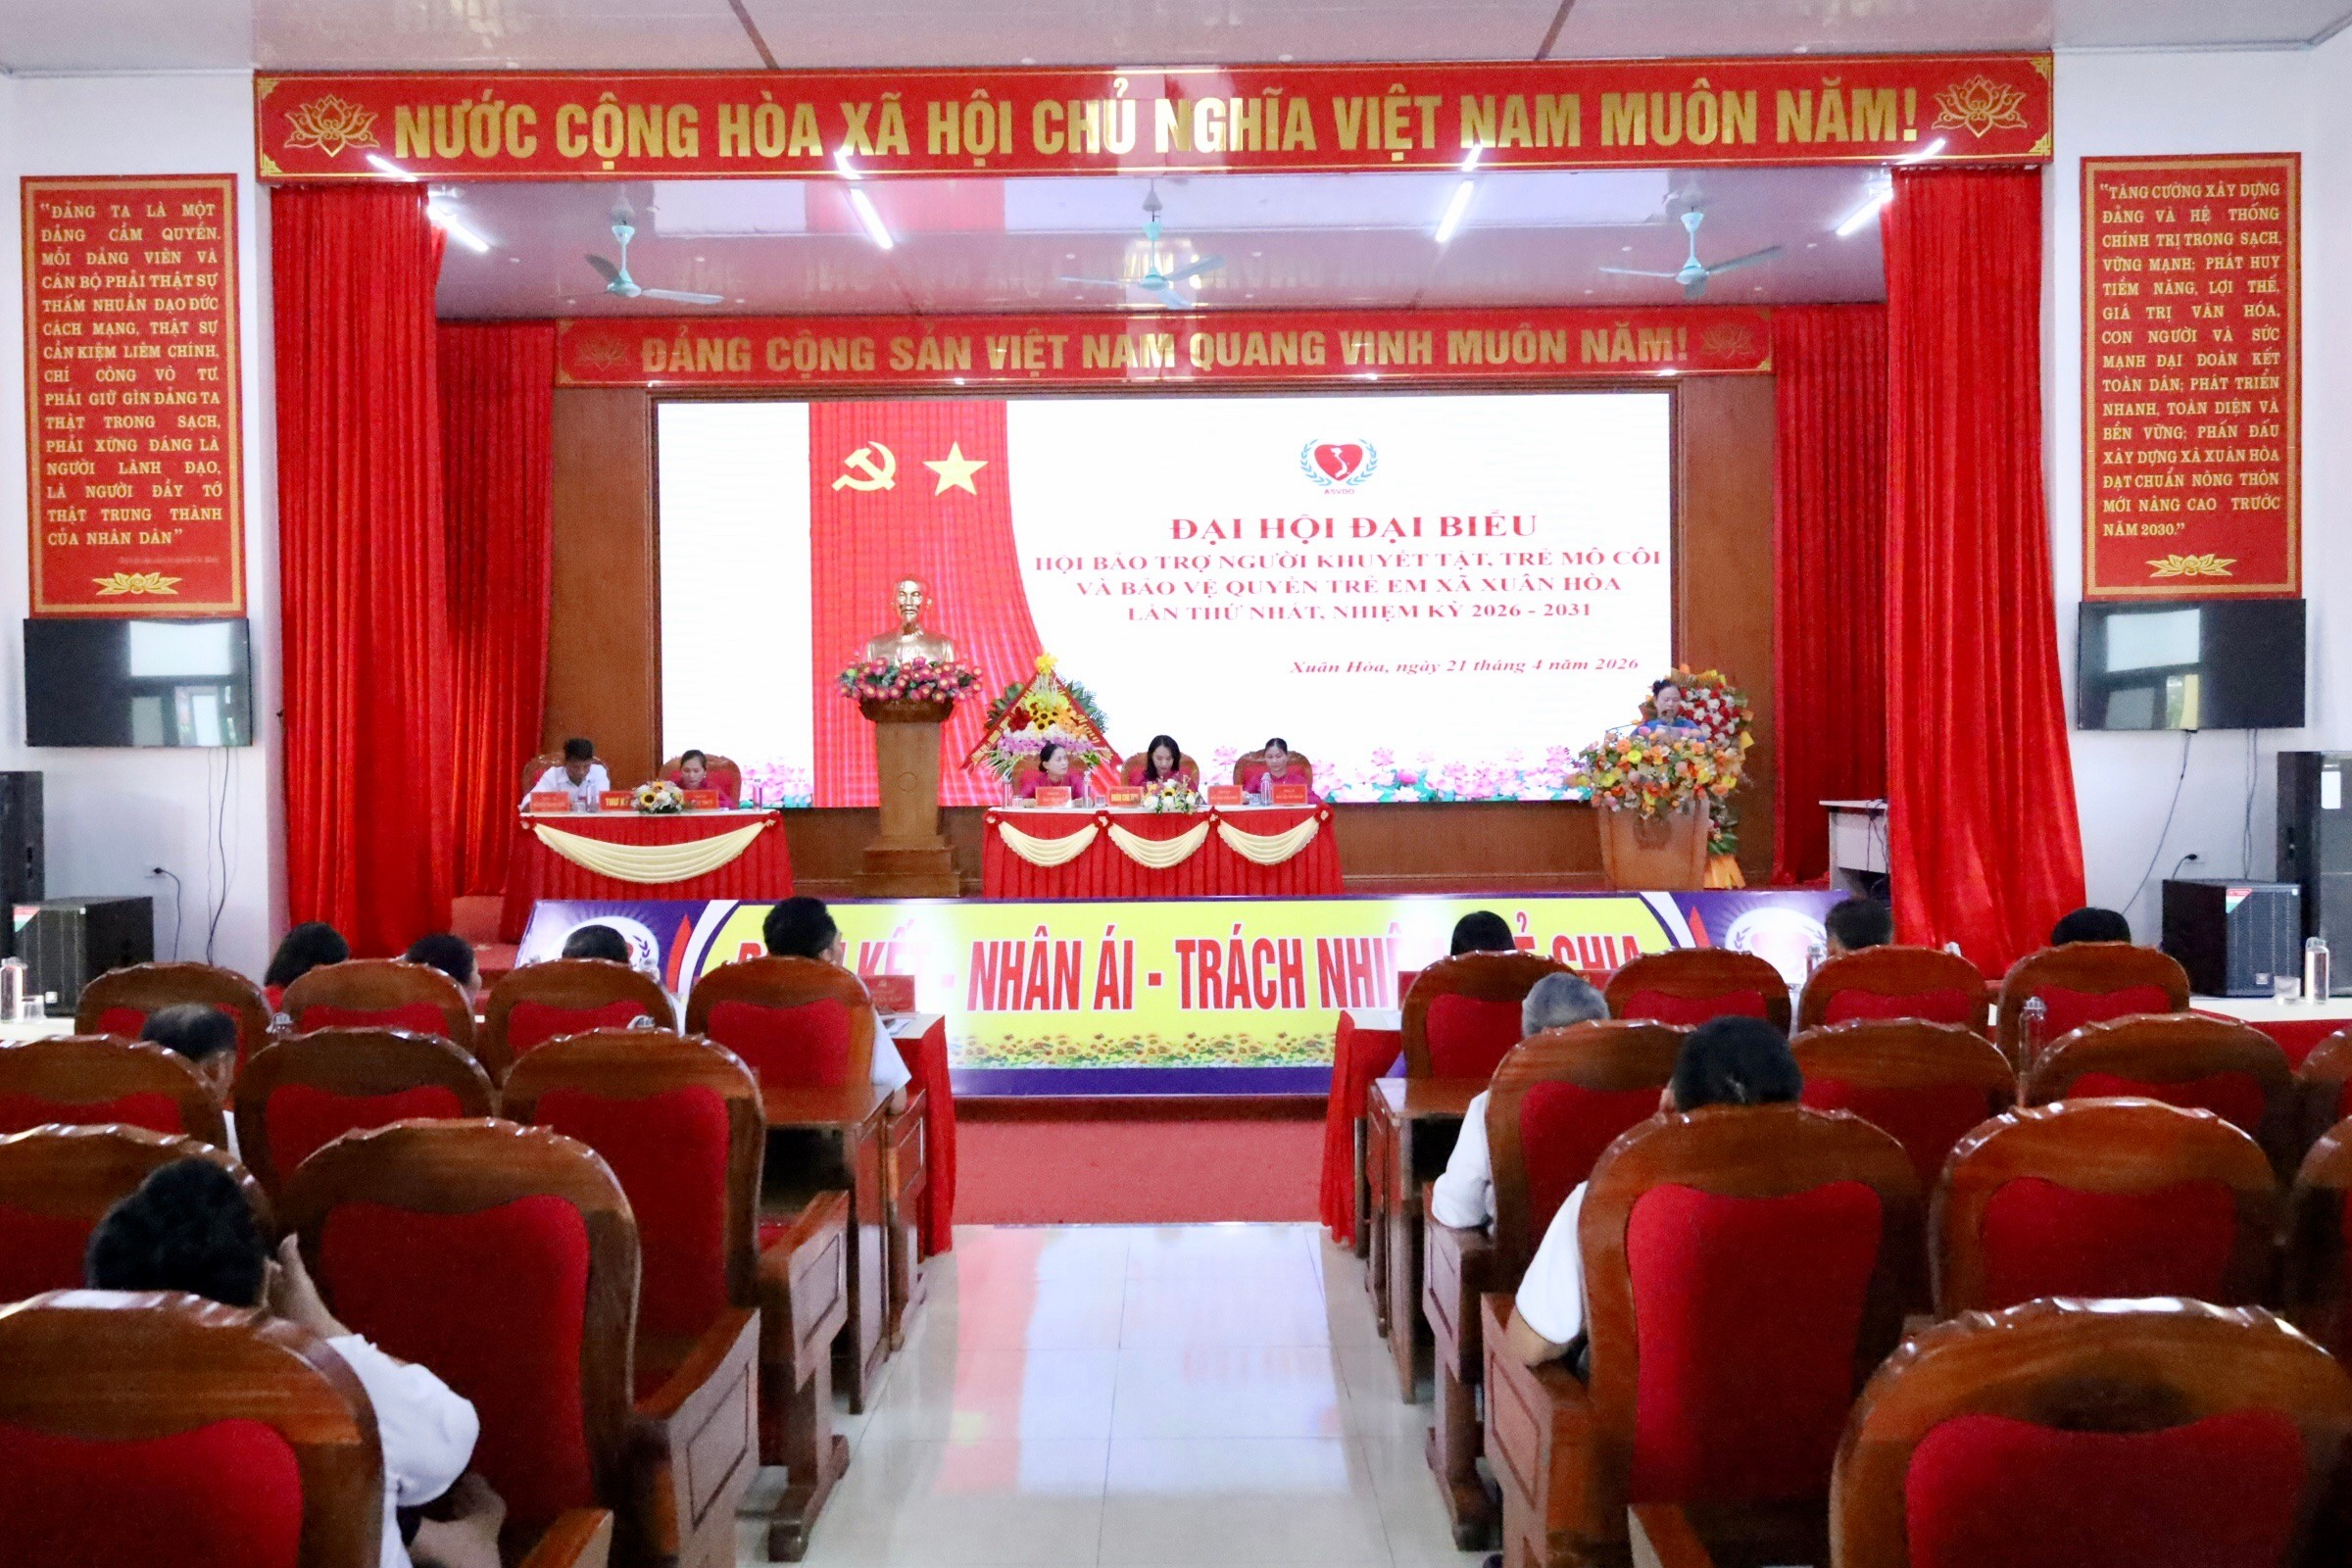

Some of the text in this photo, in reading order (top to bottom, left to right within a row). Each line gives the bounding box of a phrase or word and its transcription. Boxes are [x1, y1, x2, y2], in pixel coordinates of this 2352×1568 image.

[395, 75, 1918, 171] NƯỚC CỘNG HÒA XÃ HỘI CHỦ NGHĨA VIỆT NAM MUÔN NĂM!
[2205, 180, 2279, 198] XÂY DỰNG
[110, 205, 130, 218] TA
[146, 201, 167, 218] LÀ
[181, 200, 216, 219] MỘT
[2155, 206, 2176, 222] VÀ
[2229, 203, 2279, 220] THỐNG
[2102, 230, 2149, 248] CHÍNH
[2156, 233, 2180, 248] TRỊ
[2183, 232, 2233, 246] TRONG
[197, 248, 218, 264] VÀ
[2102, 256, 2142, 271] VỮNG
[2206, 253, 2243, 270] PHÁT
[2250, 256, 2279, 269] HUY
[42, 273, 74, 288] CÁN
[80, 272, 102, 290] BỘ
[149, 271, 193, 290] THẬT
[196, 272, 219, 290] SỰ
[2209, 279, 2232, 296] LỢI
[154, 298, 187, 314] ĐẠO
[189, 294, 219, 312] ĐỨC
[2102, 303, 2131, 320] GIÁ
[2145, 306, 2172, 321] TRỊ
[43, 320, 81, 335] CÁCH
[150, 318, 189, 337] THẬT
[199, 319, 219, 336] SỰ
[2101, 324, 2279, 344] CON NGƯỜI VÀ SỨC
[641, 320, 1688, 380] ĐẢNG CỘNG SẢN VIỆT NAM QUANG VINH MUÔN NĂM!
[2103, 348, 2280, 369] MẠNH ĐẠI ĐOÀN KẾT
[44, 367, 70, 382] CHÍ
[96, 366, 136, 382] CÔNG
[2102, 375, 2141, 392] TOÀN
[2190, 374, 2229, 390] PHÁT
[122, 389, 150, 405] GÌN
[200, 391, 220, 405] TA
[2167, 398, 2278, 416] TOÀN DIỆN VÀ
[104, 416, 155, 429] TRONG
[149, 435, 193, 452] ĐÁNG
[200, 435, 220, 452] LÀ
[2137, 446, 2279, 466] DỰNG HÒA
[47, 459, 95, 475] NGƯỜI
[2192, 470, 2232, 486] NÔNG
[2239, 469, 2278, 485] THÔN
[47, 481, 223, 499] LÀ NGƯỜI TỚ
[2102, 493, 2279, 513] MỚI NÂNG CAO TRƯỚC
[101, 505, 223, 521] TRUNG THÀNH
[1170, 516, 1242, 546] ĐẠI
[1258, 513, 1335, 545] HỘI
[1348, 515, 1423, 544] ĐẠI
[2102, 520, 2138, 537] NĂM
[1035, 554, 1083, 574] HỘI
[1154, 554, 1211, 572] TRỢ
[1219, 551, 1307, 569] NGƯỜI
[1560, 546, 1605, 565] MÔ
[1613, 546, 1661, 565] CÔI
[1076, 577, 1112, 597] VÀ
[1184, 578, 1218, 599] VỆ
[1388, 578, 1427, 593] EM
[1436, 574, 1472, 592] XÃ
[1482, 572, 1554, 592] XUÂN
[1563, 572, 1622, 591] HÒA
[1186, 603, 1244, 620] THỨ
[1333, 603, 1419, 623] NHIỆM
[1472, 603, 1522, 617] 2026
[1544, 602, 1592, 616] 2031
[1290, 657, 1640, 675] Xuân Hòa, ngày 21 tháng 4 năm 2026
[966, 925, 1082, 1010] NHÂN
[1094, 925, 1134, 1010] ÁI
[1175, 923, 1306, 1009] TRÁCH
